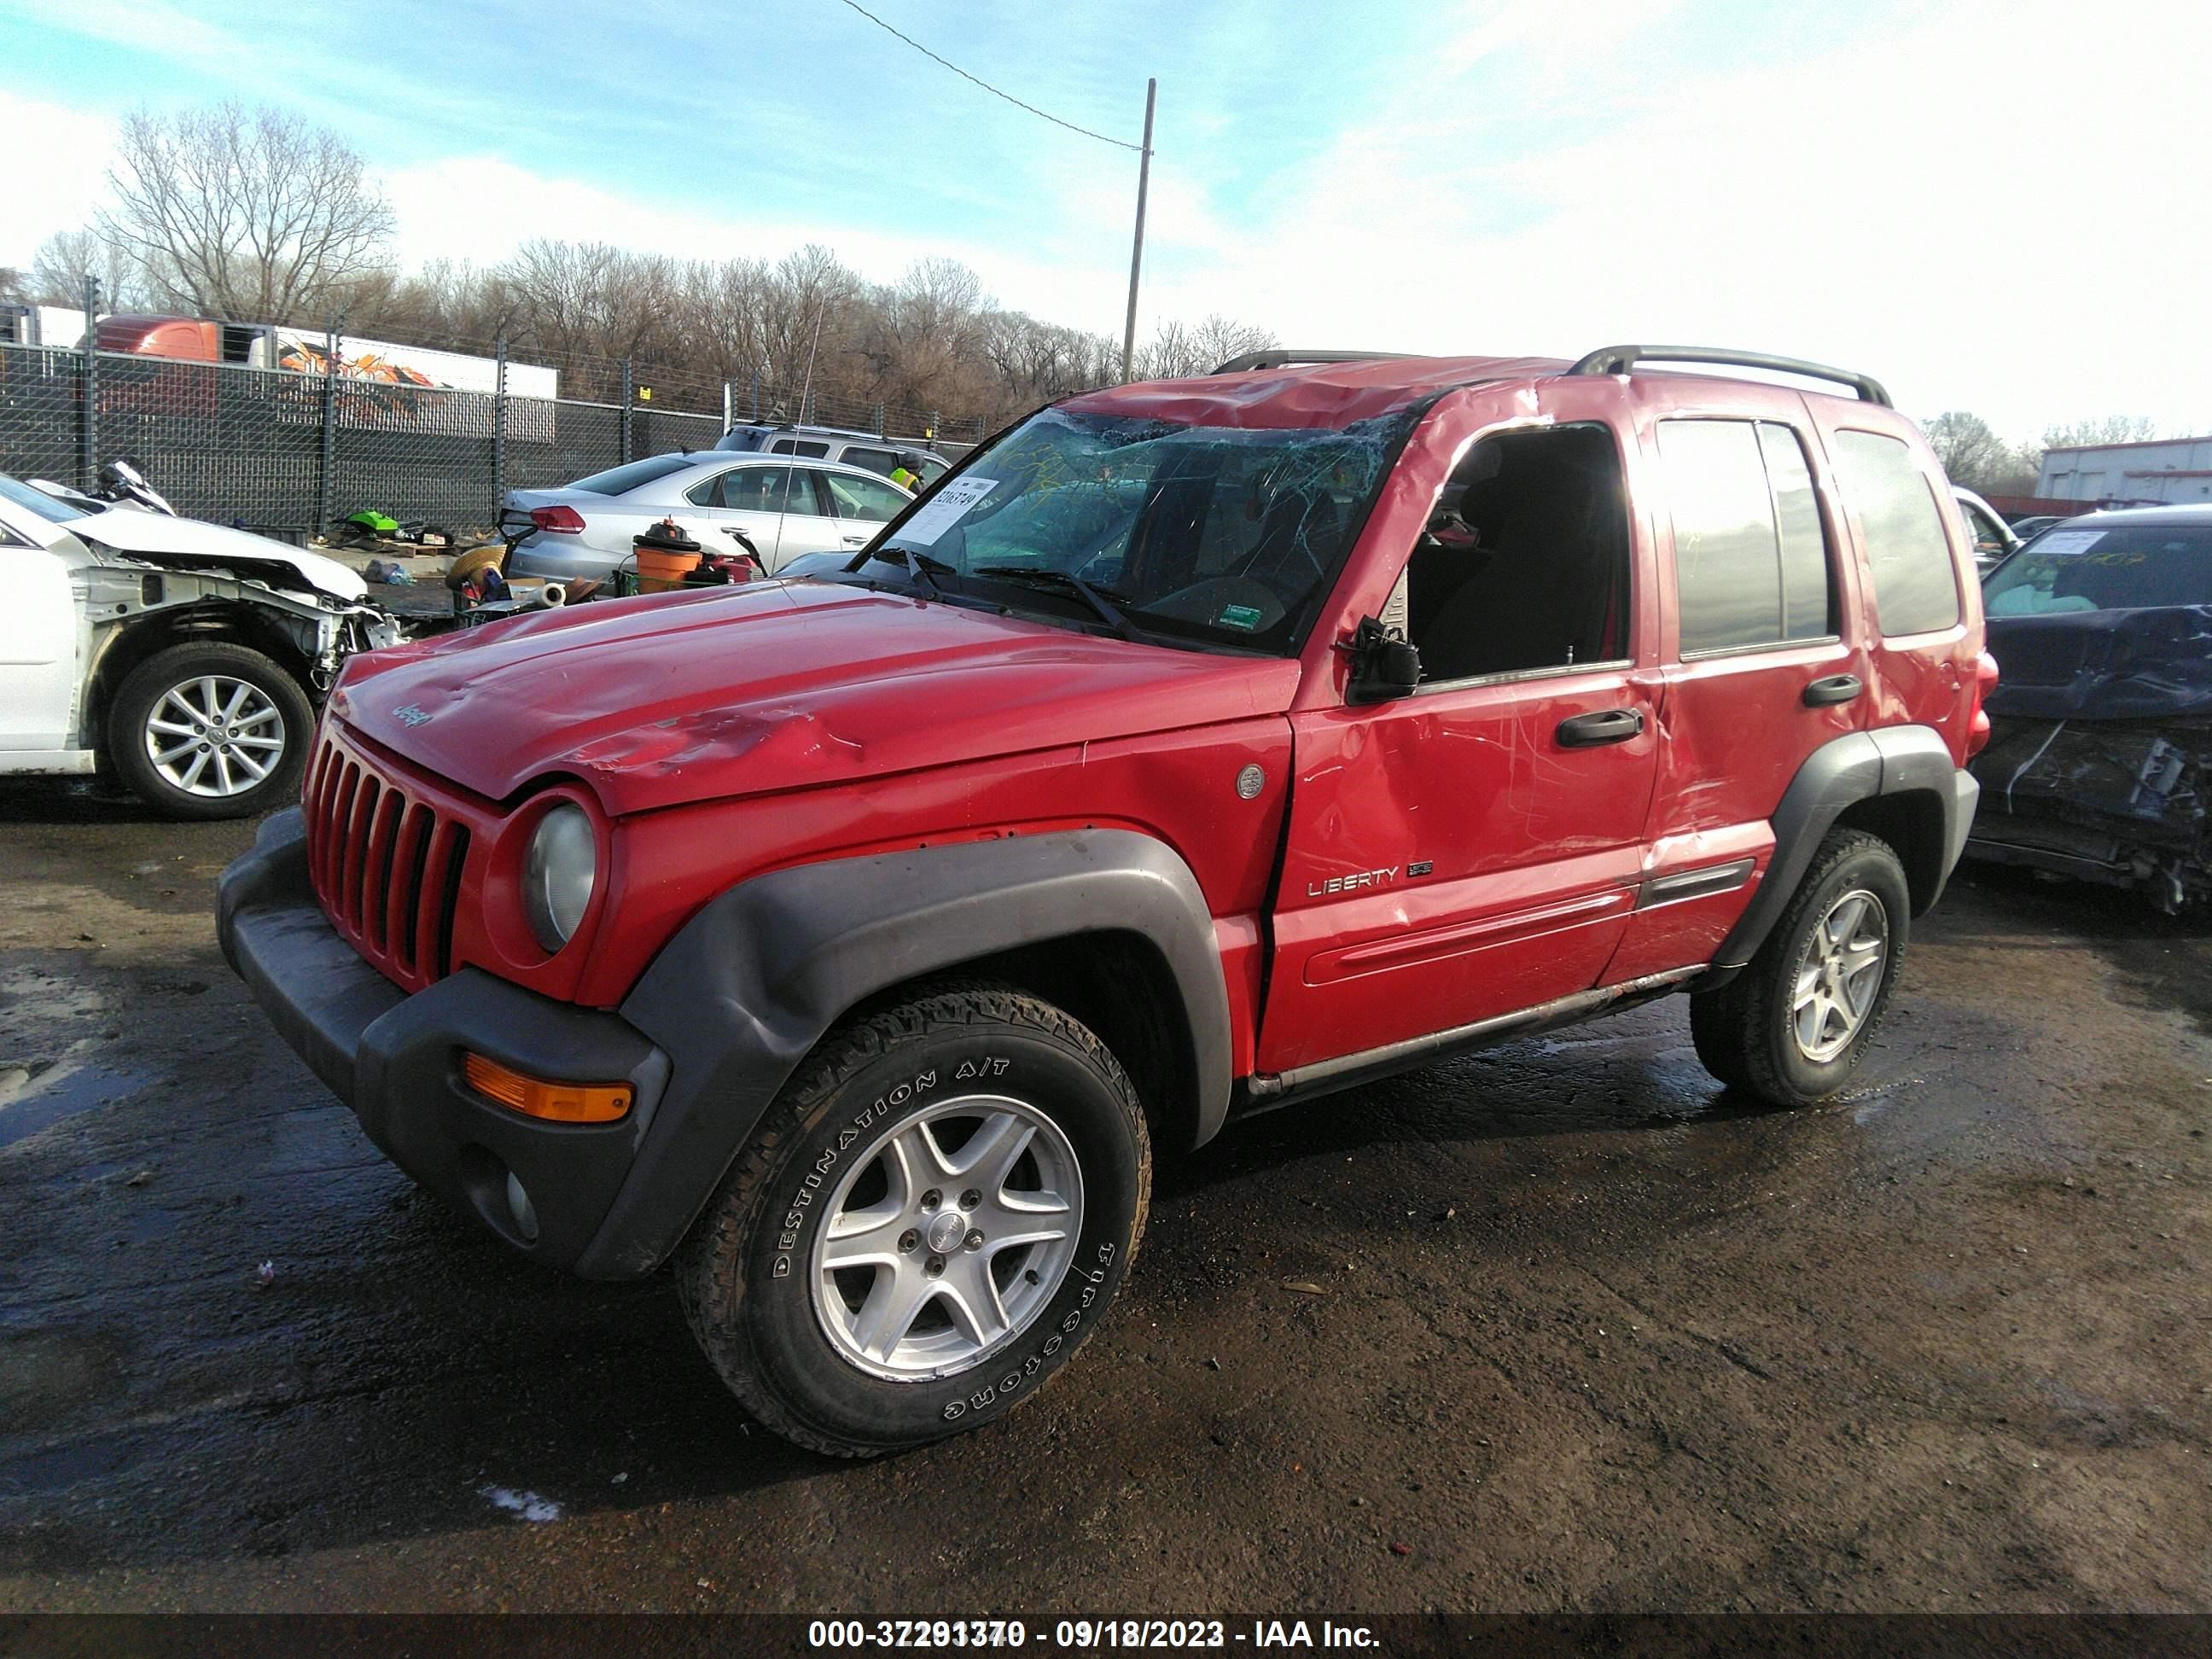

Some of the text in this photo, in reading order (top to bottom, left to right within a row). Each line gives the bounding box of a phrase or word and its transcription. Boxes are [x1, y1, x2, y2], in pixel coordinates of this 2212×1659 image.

[392, 702, 434, 729] Jeep
[1307, 865, 1399, 896] LIBERTY
[771, 1056, 1011, 1278] DESTINATION A/T
